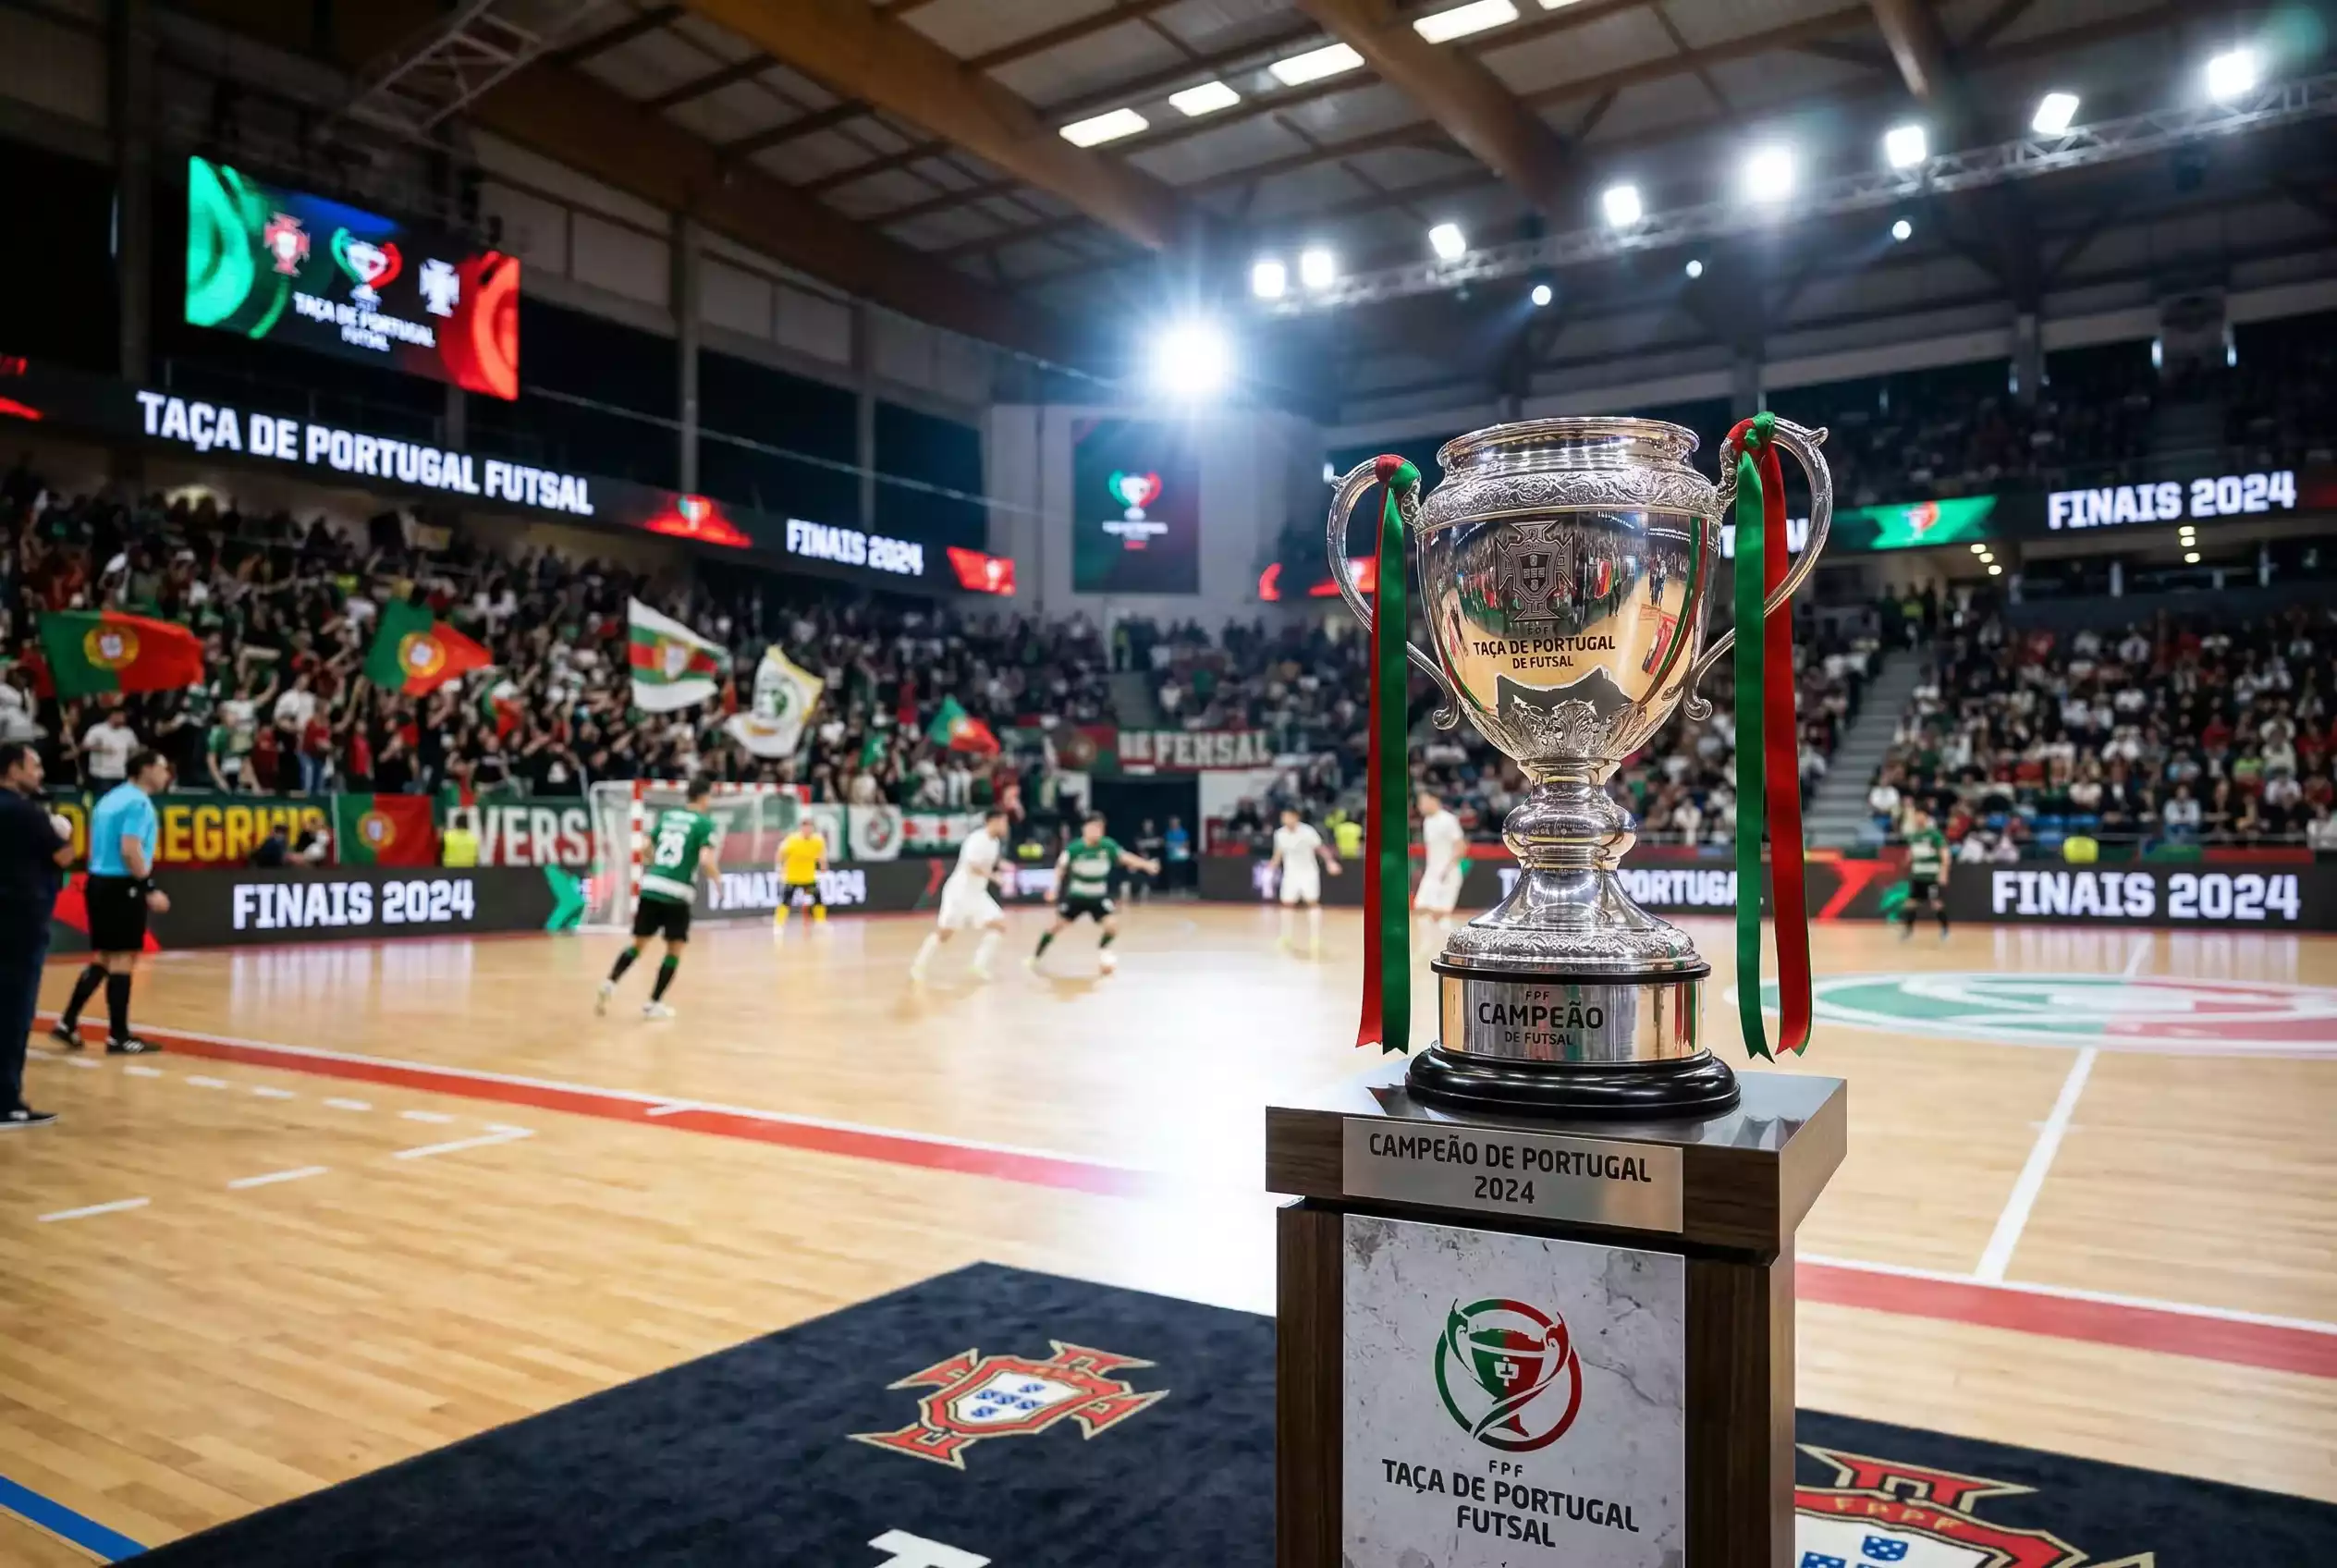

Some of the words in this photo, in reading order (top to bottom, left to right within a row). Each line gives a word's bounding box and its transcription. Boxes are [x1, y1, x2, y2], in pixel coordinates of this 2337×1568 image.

[136, 390, 242, 452] TAÇA
[249, 413, 299, 460] DE
[306, 423, 480, 495] PORTUGAL
[484, 459, 594, 516] FUTSAL
[2048, 481, 2183, 530] FINAIS
[2190, 470, 2297, 518] 2024
[786, 518, 867, 566] FINAIS
[867, 534, 924, 576] 2024
[1473, 641, 1507, 658] TAÇA
[1510, 639, 1530, 655] DE
[1533, 635, 1616, 654] PORTUGAL
[1512, 657, 1527, 668] DE
[1530, 655, 1573, 668] FUTSAL
[233, 882, 372, 929] FINAIS
[382, 879, 474, 924] 2024
[1619, 869, 1739, 905] PORTUGA
[1992, 871, 2156, 917] FINAIS
[2168, 874, 2301, 920] 2024
[1479, 1001, 1604, 1029] CAMPEÃO
[1525, 991, 1550, 1000] FPF
[1505, 1031, 1521, 1043] DE
[1524, 1033, 1574, 1046] FUTSAL
[1369, 1133, 1478, 1165] CAMPEÃO
[1485, 1144, 1514, 1170] DE
[1522, 1147, 1653, 1182] PORTUGAL
[1474, 1175, 1535, 1204] 2024
[1488, 1460, 1523, 1477] FPF
[1382, 1459, 1446, 1494] TAÇA
[1452, 1472, 1486, 1501] DE
[1494, 1481, 1640, 1533] PORTUGAL
[1457, 1505, 1556, 1548] FUTSAL
